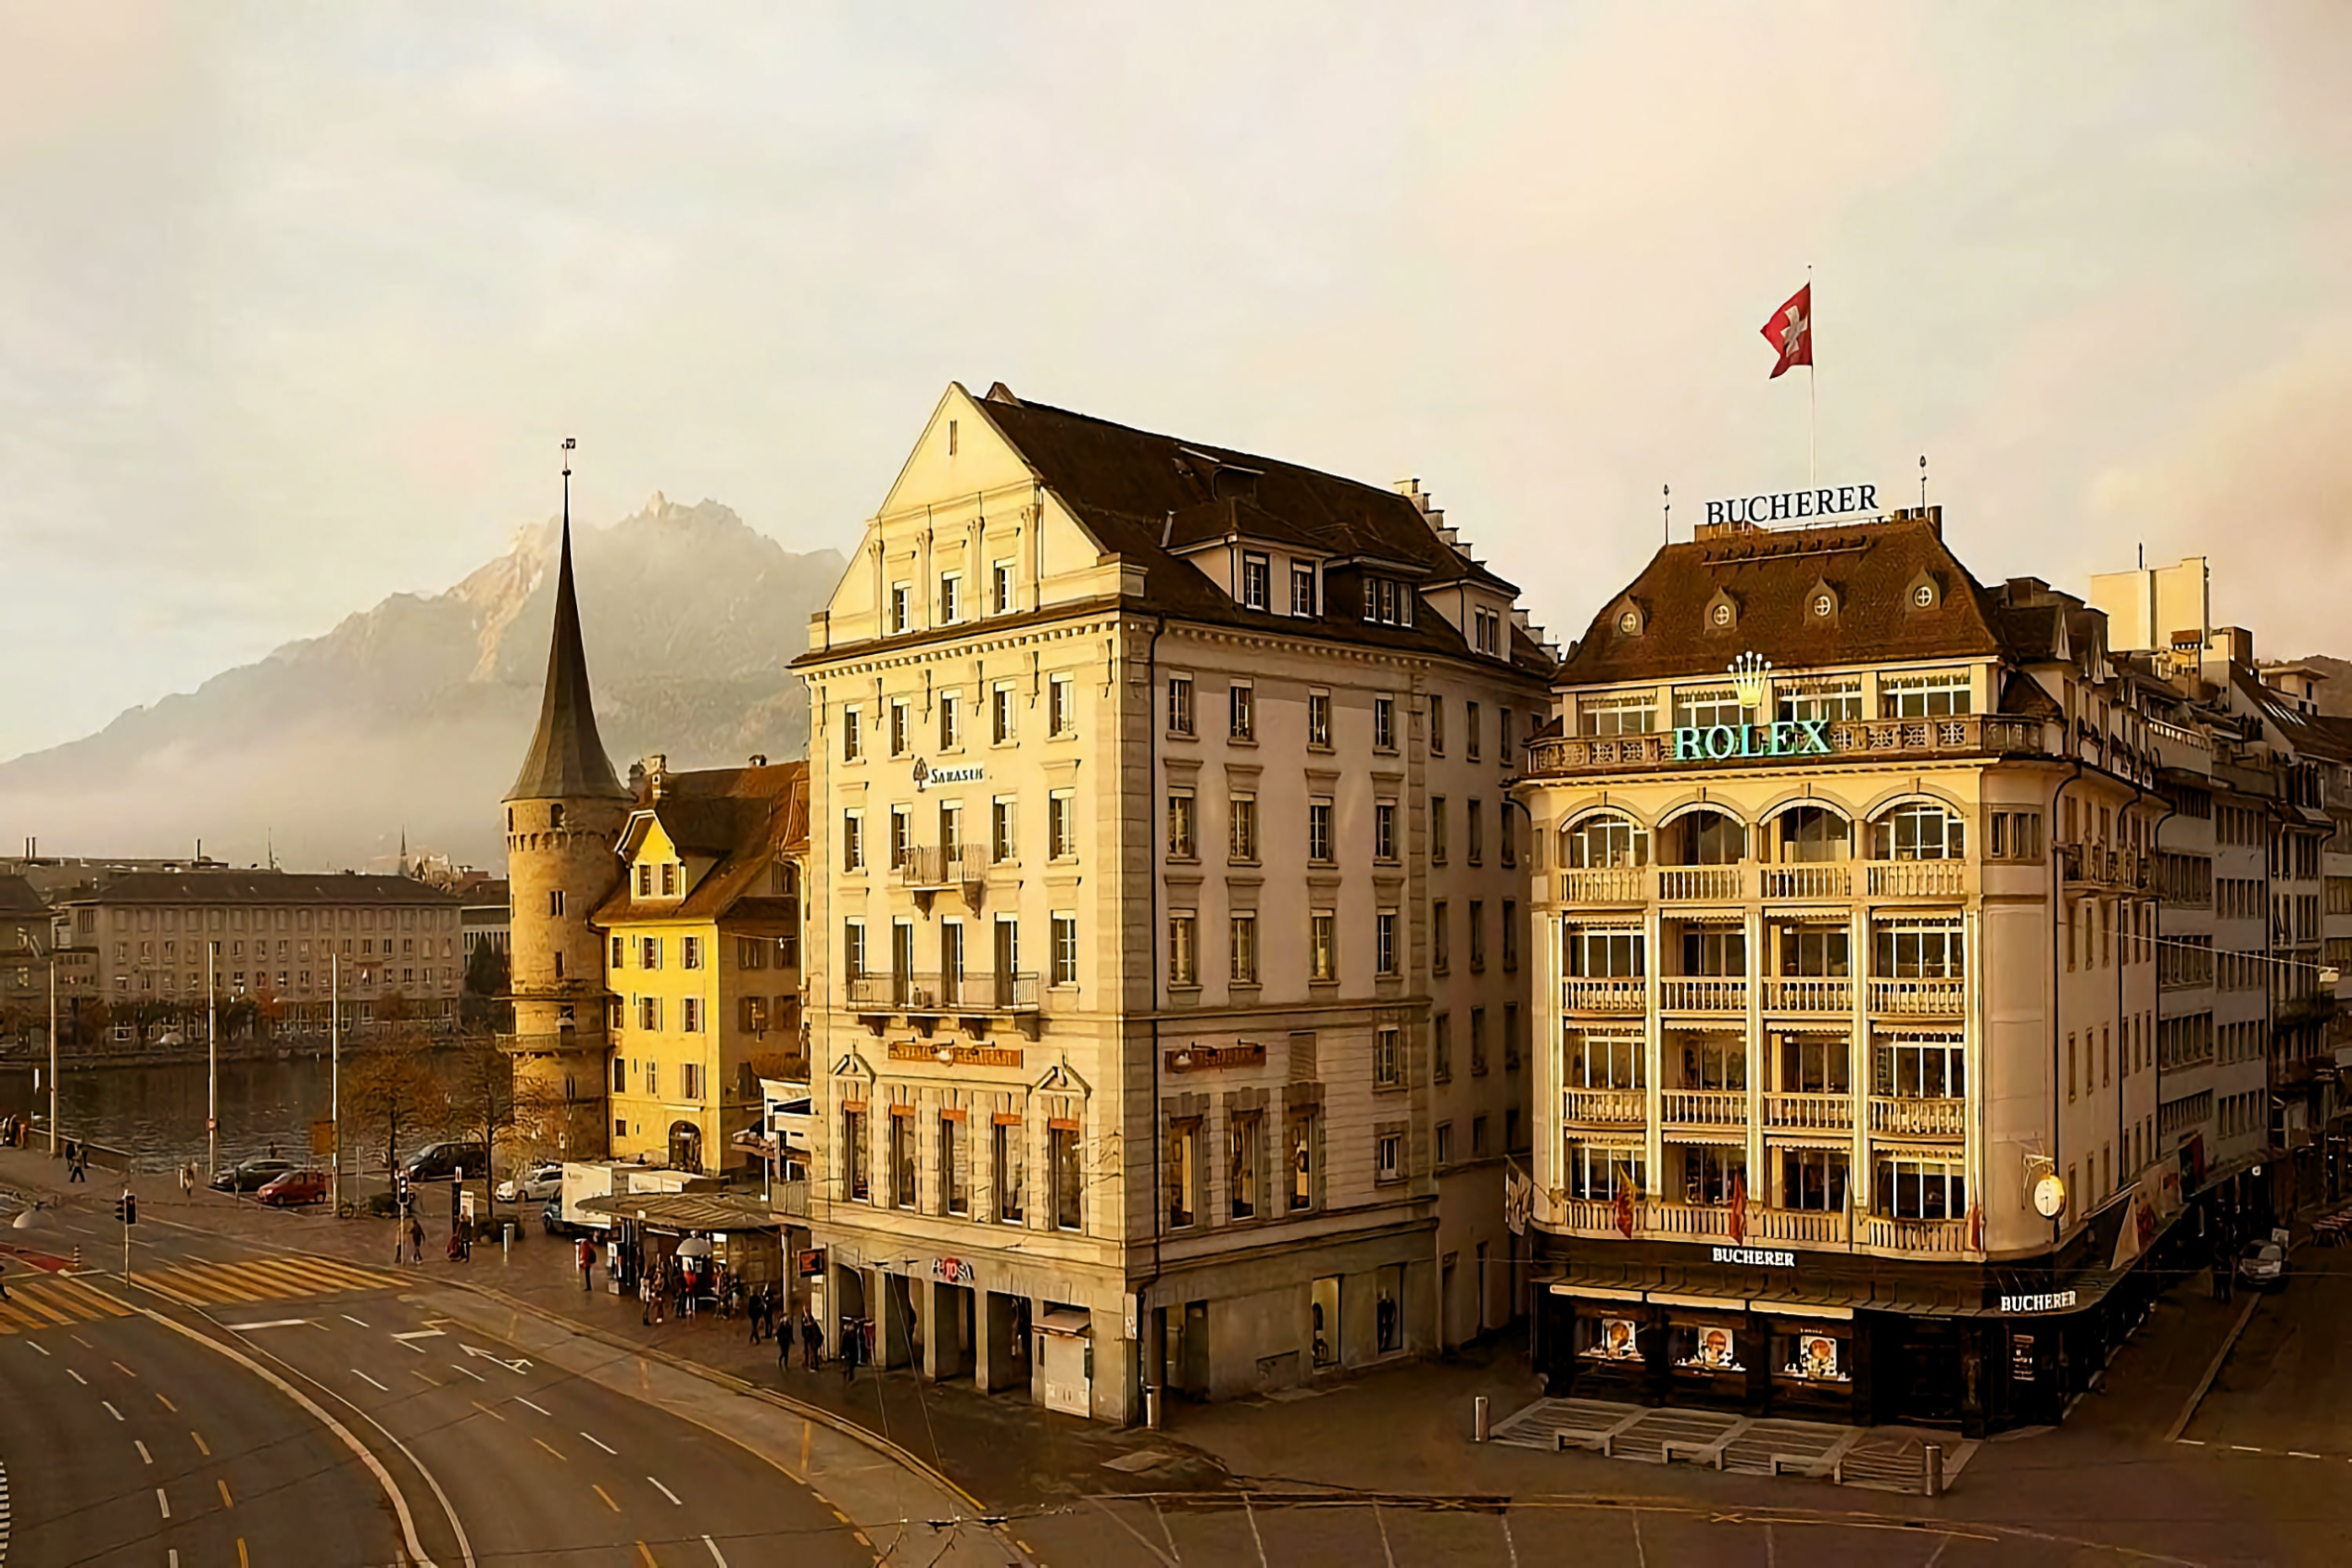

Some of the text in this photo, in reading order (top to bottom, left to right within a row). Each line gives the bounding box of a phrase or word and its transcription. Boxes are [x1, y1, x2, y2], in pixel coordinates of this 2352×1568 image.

[1705, 484, 1879, 526] BUCHERER
[1674, 720, 1831, 759] ROLEX
[1712, 1247, 1795, 1267] BUCHERER
[2001, 1290, 2076, 1311] BUCHERER
